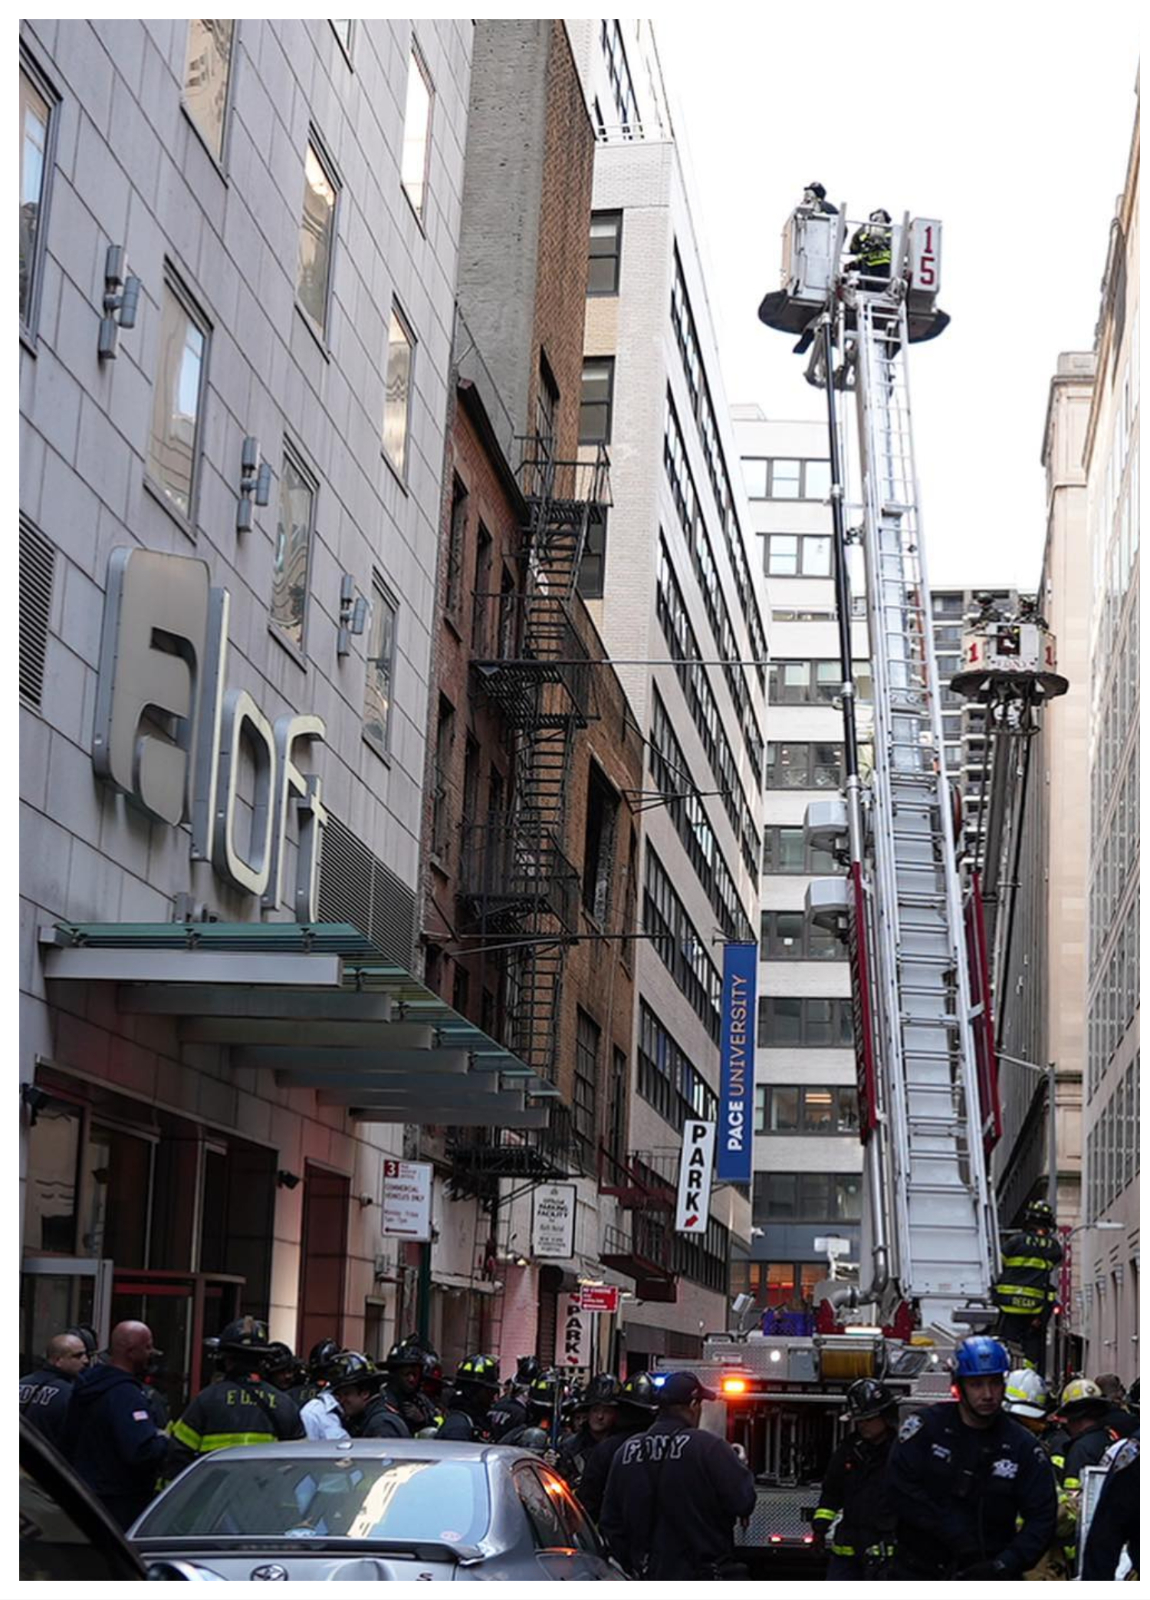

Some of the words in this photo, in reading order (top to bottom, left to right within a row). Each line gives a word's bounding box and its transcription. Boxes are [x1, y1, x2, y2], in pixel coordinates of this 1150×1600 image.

[920, 225, 936, 286] 15
[968, 642, 979, 663] 1
[1044, 645, 1054, 667] 1
[93, 545, 328, 926] aloft
[728, 974, 747, 1097] UNIVERSITY
[726, 1100, 744, 1151] PACE
[386, 1161, 397, 1177] 3
[684, 1124, 707, 1213] PARK
[565, 1305, 582, 1354] PARK
